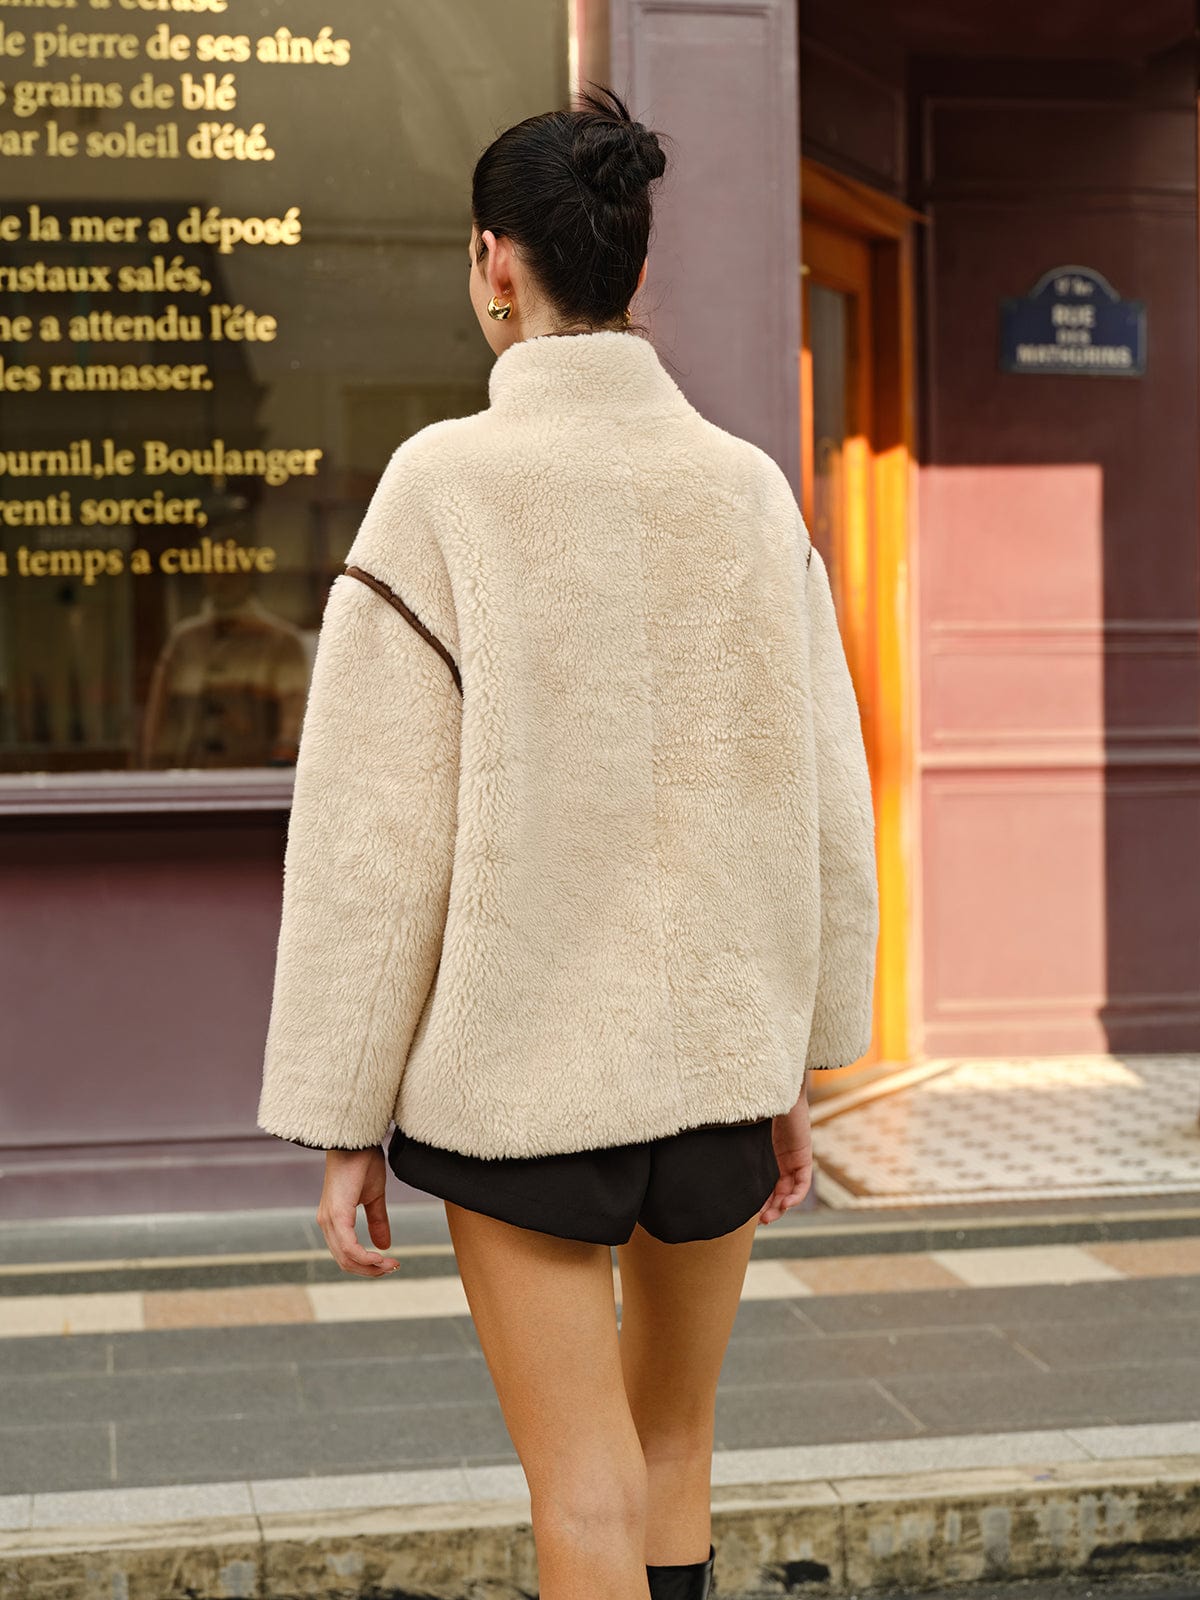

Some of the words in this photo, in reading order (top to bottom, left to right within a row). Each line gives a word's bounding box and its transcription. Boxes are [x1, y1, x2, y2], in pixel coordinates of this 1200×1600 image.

[34, 25, 139, 67] pierre
[147, 24, 190, 60] de
[197, 35, 251, 62] ses
[257, 27, 350, 66] aînés
[14, 74, 123, 117] grains
[130, 73, 174, 108] de
[181, 73, 236, 110] blé
[0, 131, 39, 155] ar
[47, 121, 78, 156] le
[87, 122, 179, 158] soleil
[188, 123, 275, 160] d'été.
[29, 205, 61, 241] la
[71, 217, 141, 242] mer
[149, 218, 169, 242] a
[178, 207, 301, 253] déposé
[119, 256, 211, 295] salés,
[40, 316, 61, 341] a
[69, 305, 202, 341] attendu
[50, 365, 213, 390] ramasser.
[144, 440, 323, 486] Boulanger
[0, 492, 71, 525] enti
[81, 491, 207, 526] sorcier,
[18, 547, 123, 585] temps
[131, 550, 151, 573] a
[160, 537, 279, 573] cultive
